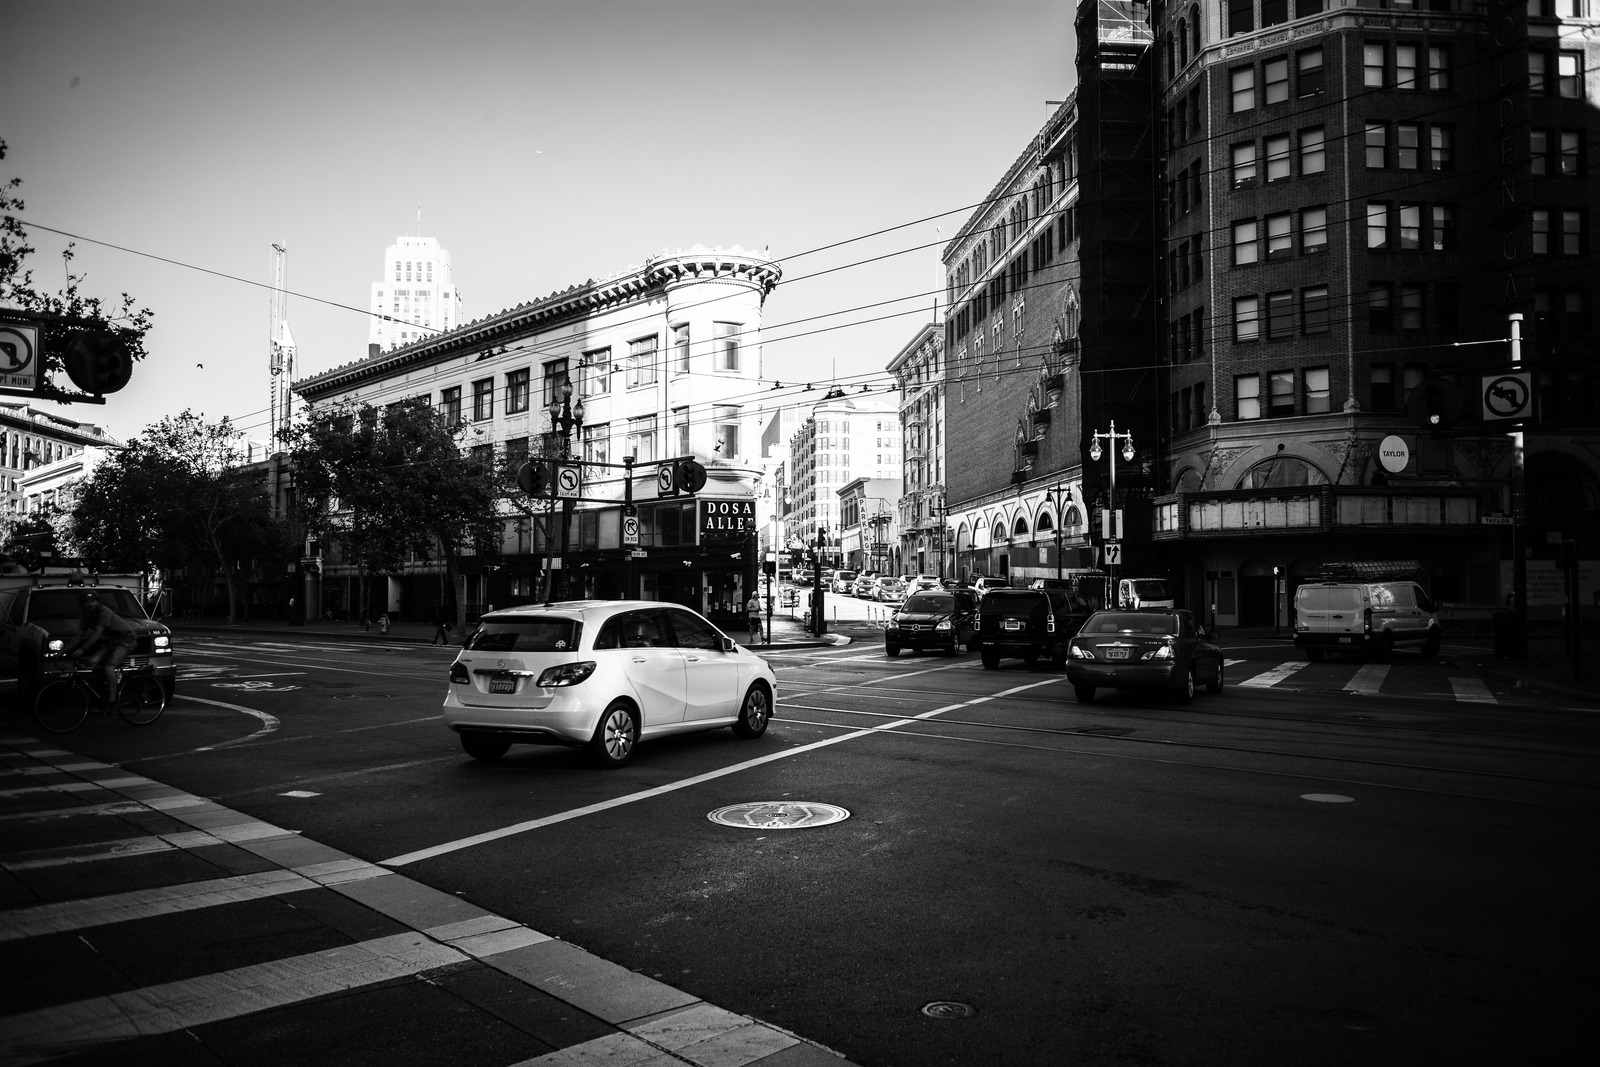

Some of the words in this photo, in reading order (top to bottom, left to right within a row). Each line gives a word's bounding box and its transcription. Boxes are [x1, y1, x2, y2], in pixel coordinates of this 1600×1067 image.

[1494, 0, 1516, 209] OLDEN
[1503, 231, 1520, 304] GA
[12, 377, 30, 385] MUNI
[1382, 450, 1405, 458] TAYLOR
[707, 502, 752, 514] DOSA
